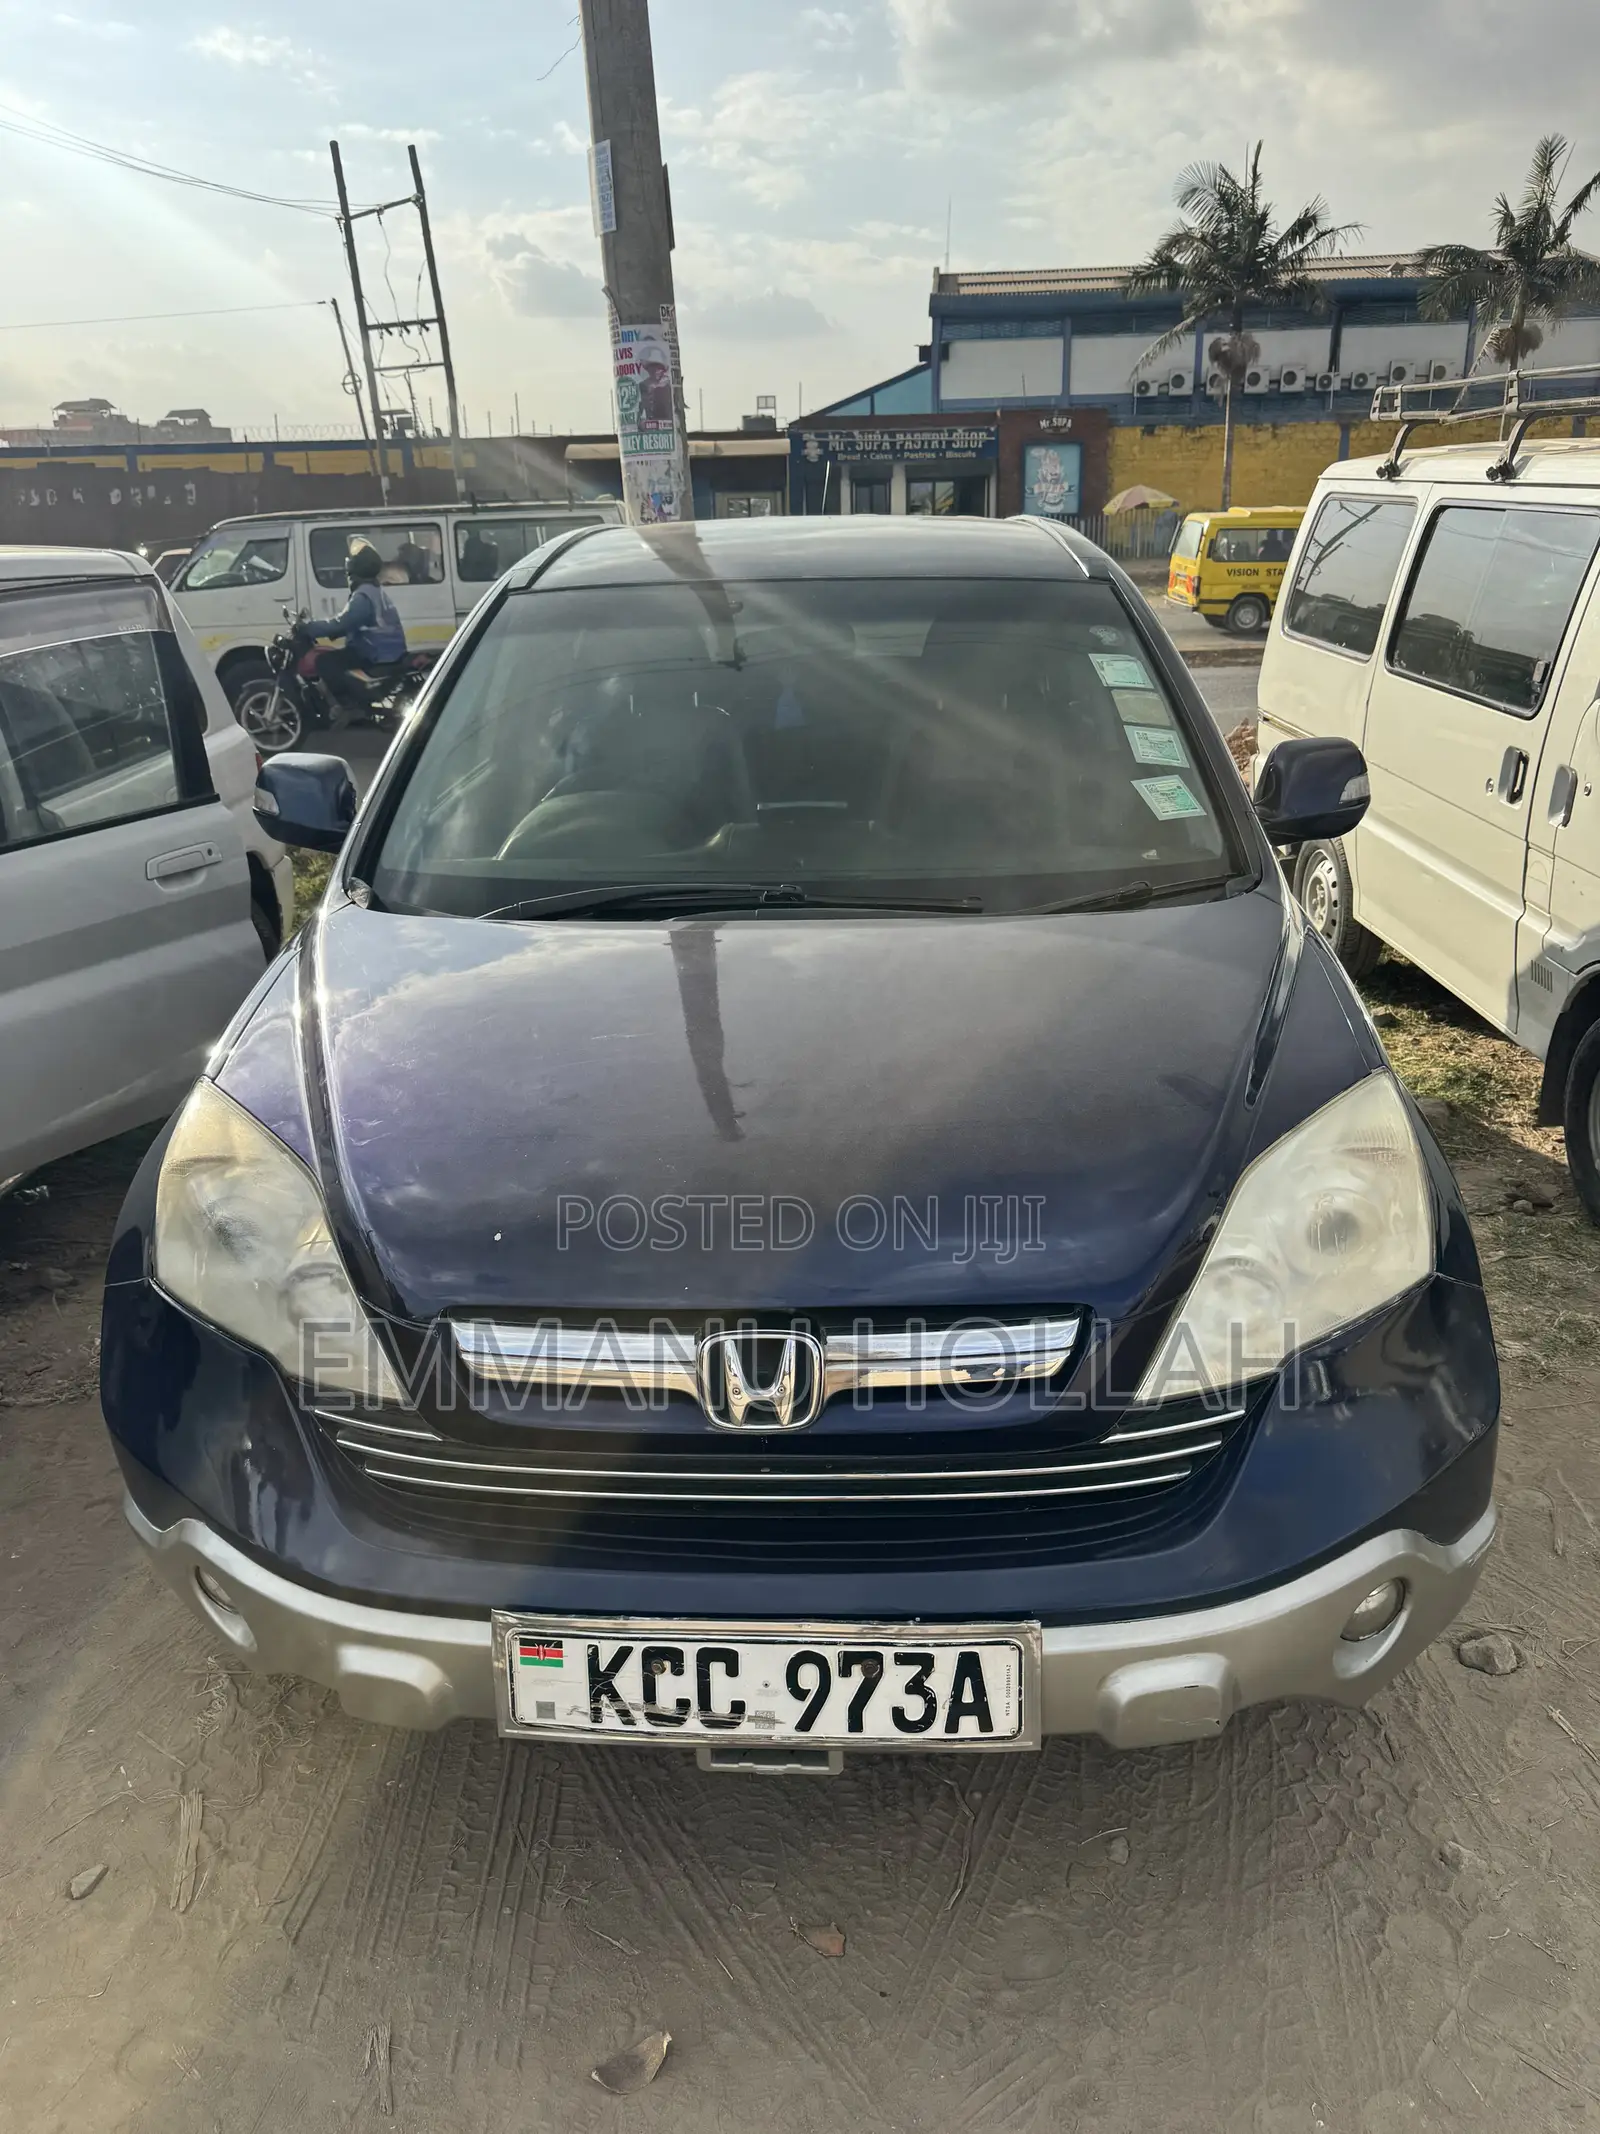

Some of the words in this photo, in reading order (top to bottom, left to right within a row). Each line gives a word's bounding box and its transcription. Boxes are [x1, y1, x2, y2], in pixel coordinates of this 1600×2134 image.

[642, 433, 673, 450] RESORT
[855, 431, 891, 451] SUPA
[896, 430, 949, 450] PASTRY
[951, 429, 987, 449] SHOP
[1226, 567, 1260, 577] VISION
[587, 1643, 747, 1730] KCC
[784, 1649, 995, 1734] 973A
